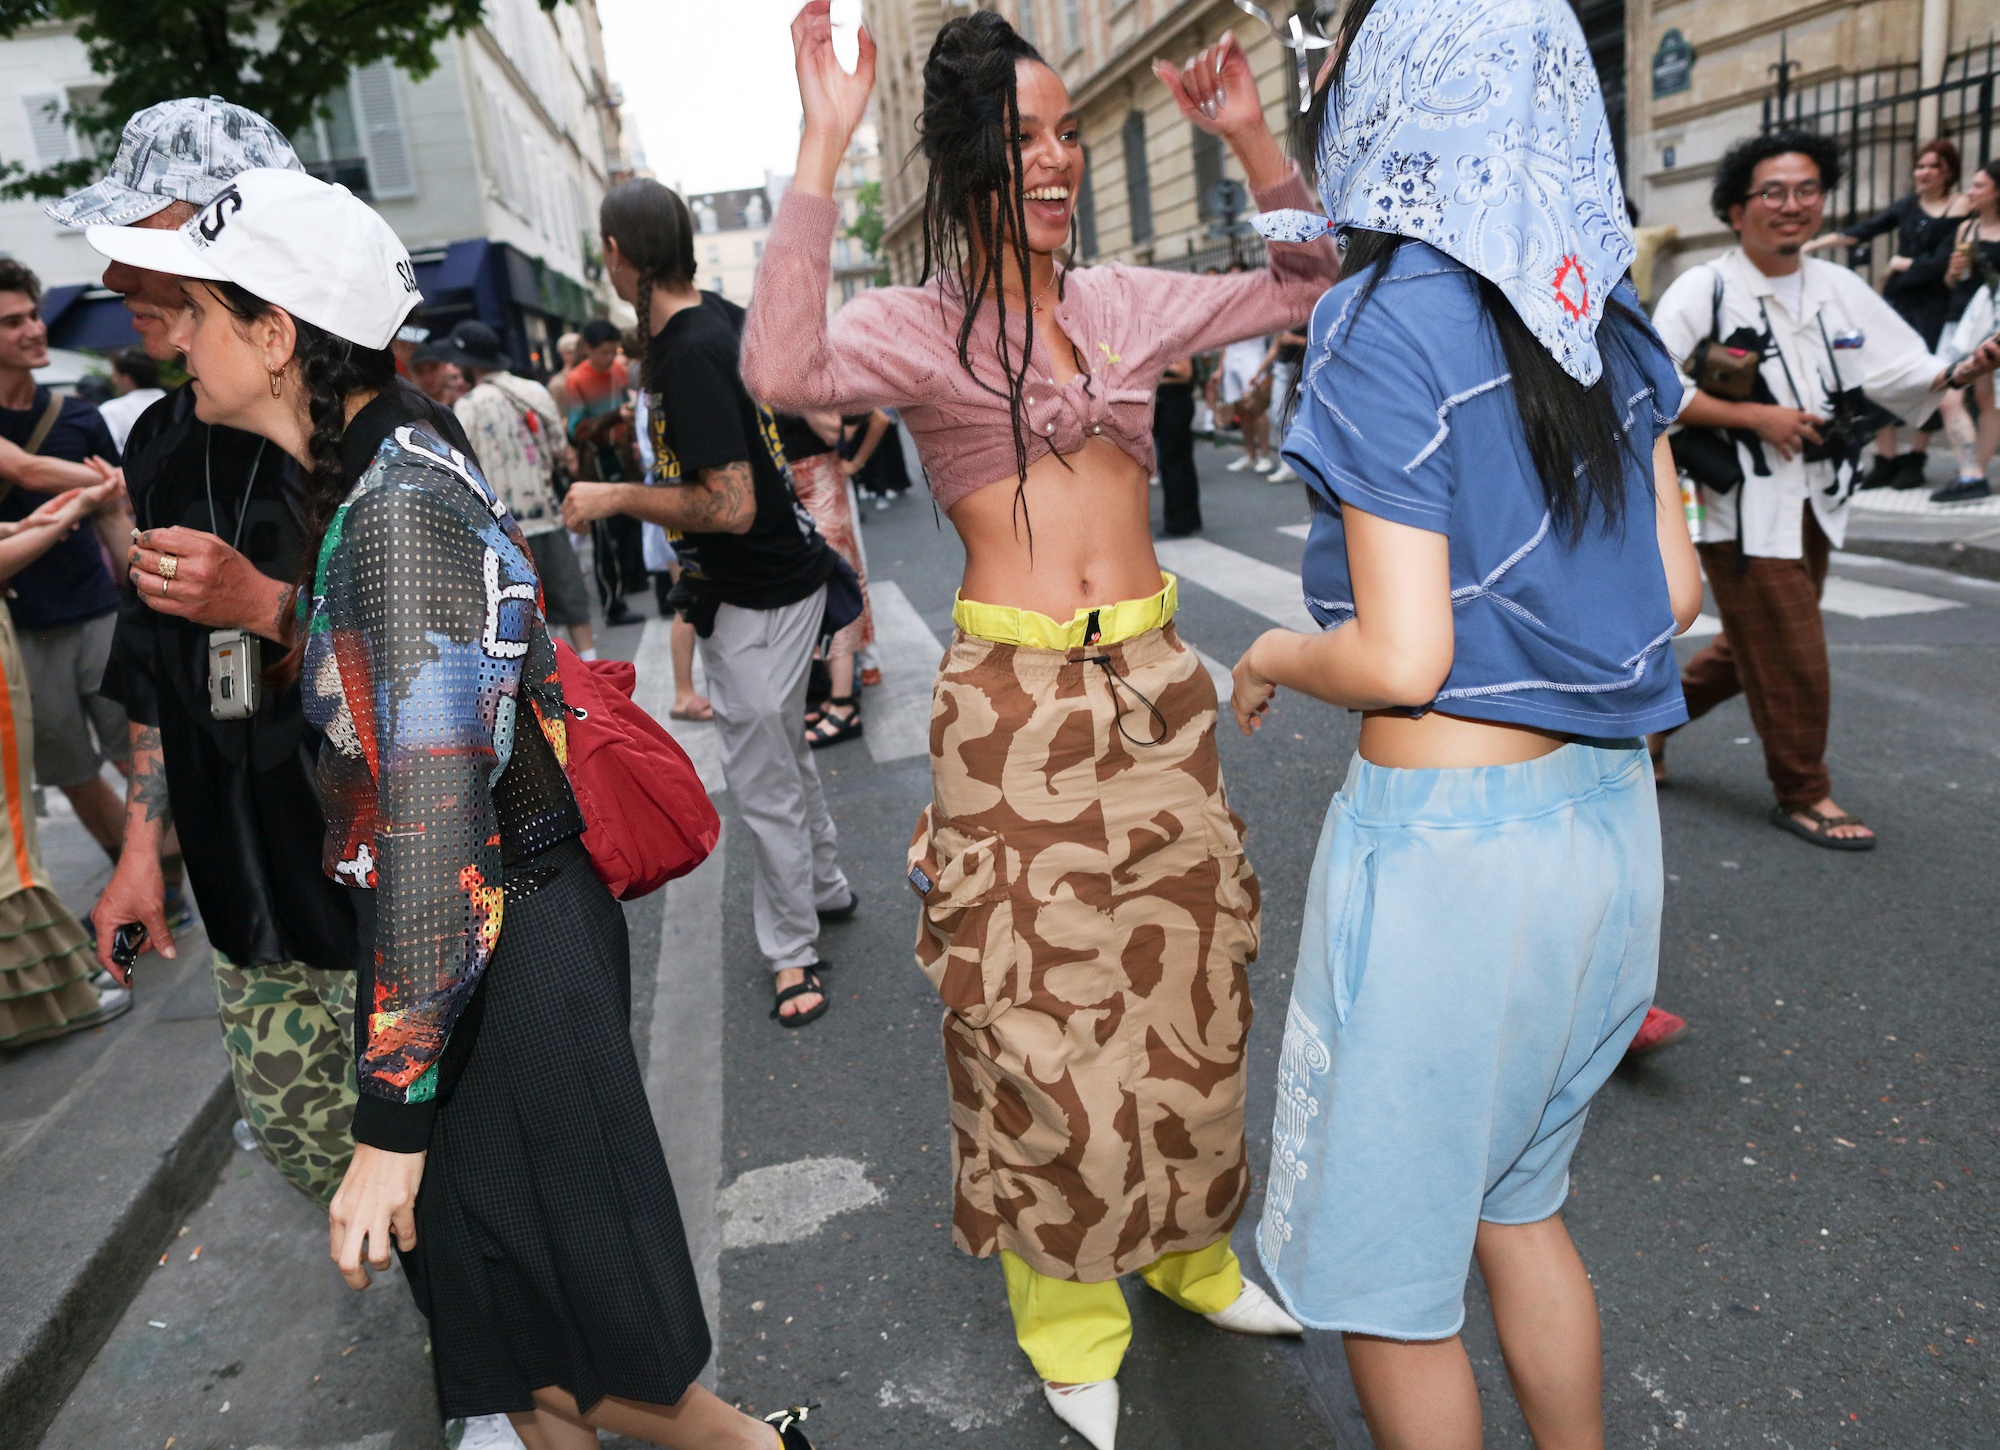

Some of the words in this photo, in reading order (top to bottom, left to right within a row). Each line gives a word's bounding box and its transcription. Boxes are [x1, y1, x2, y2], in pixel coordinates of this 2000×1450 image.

[396, 259, 417, 293] SA
[1278, 1061, 1319, 1117] ries
[1272, 1122, 1308, 1181] ries
[1267, 1182, 1293, 1242] ries
